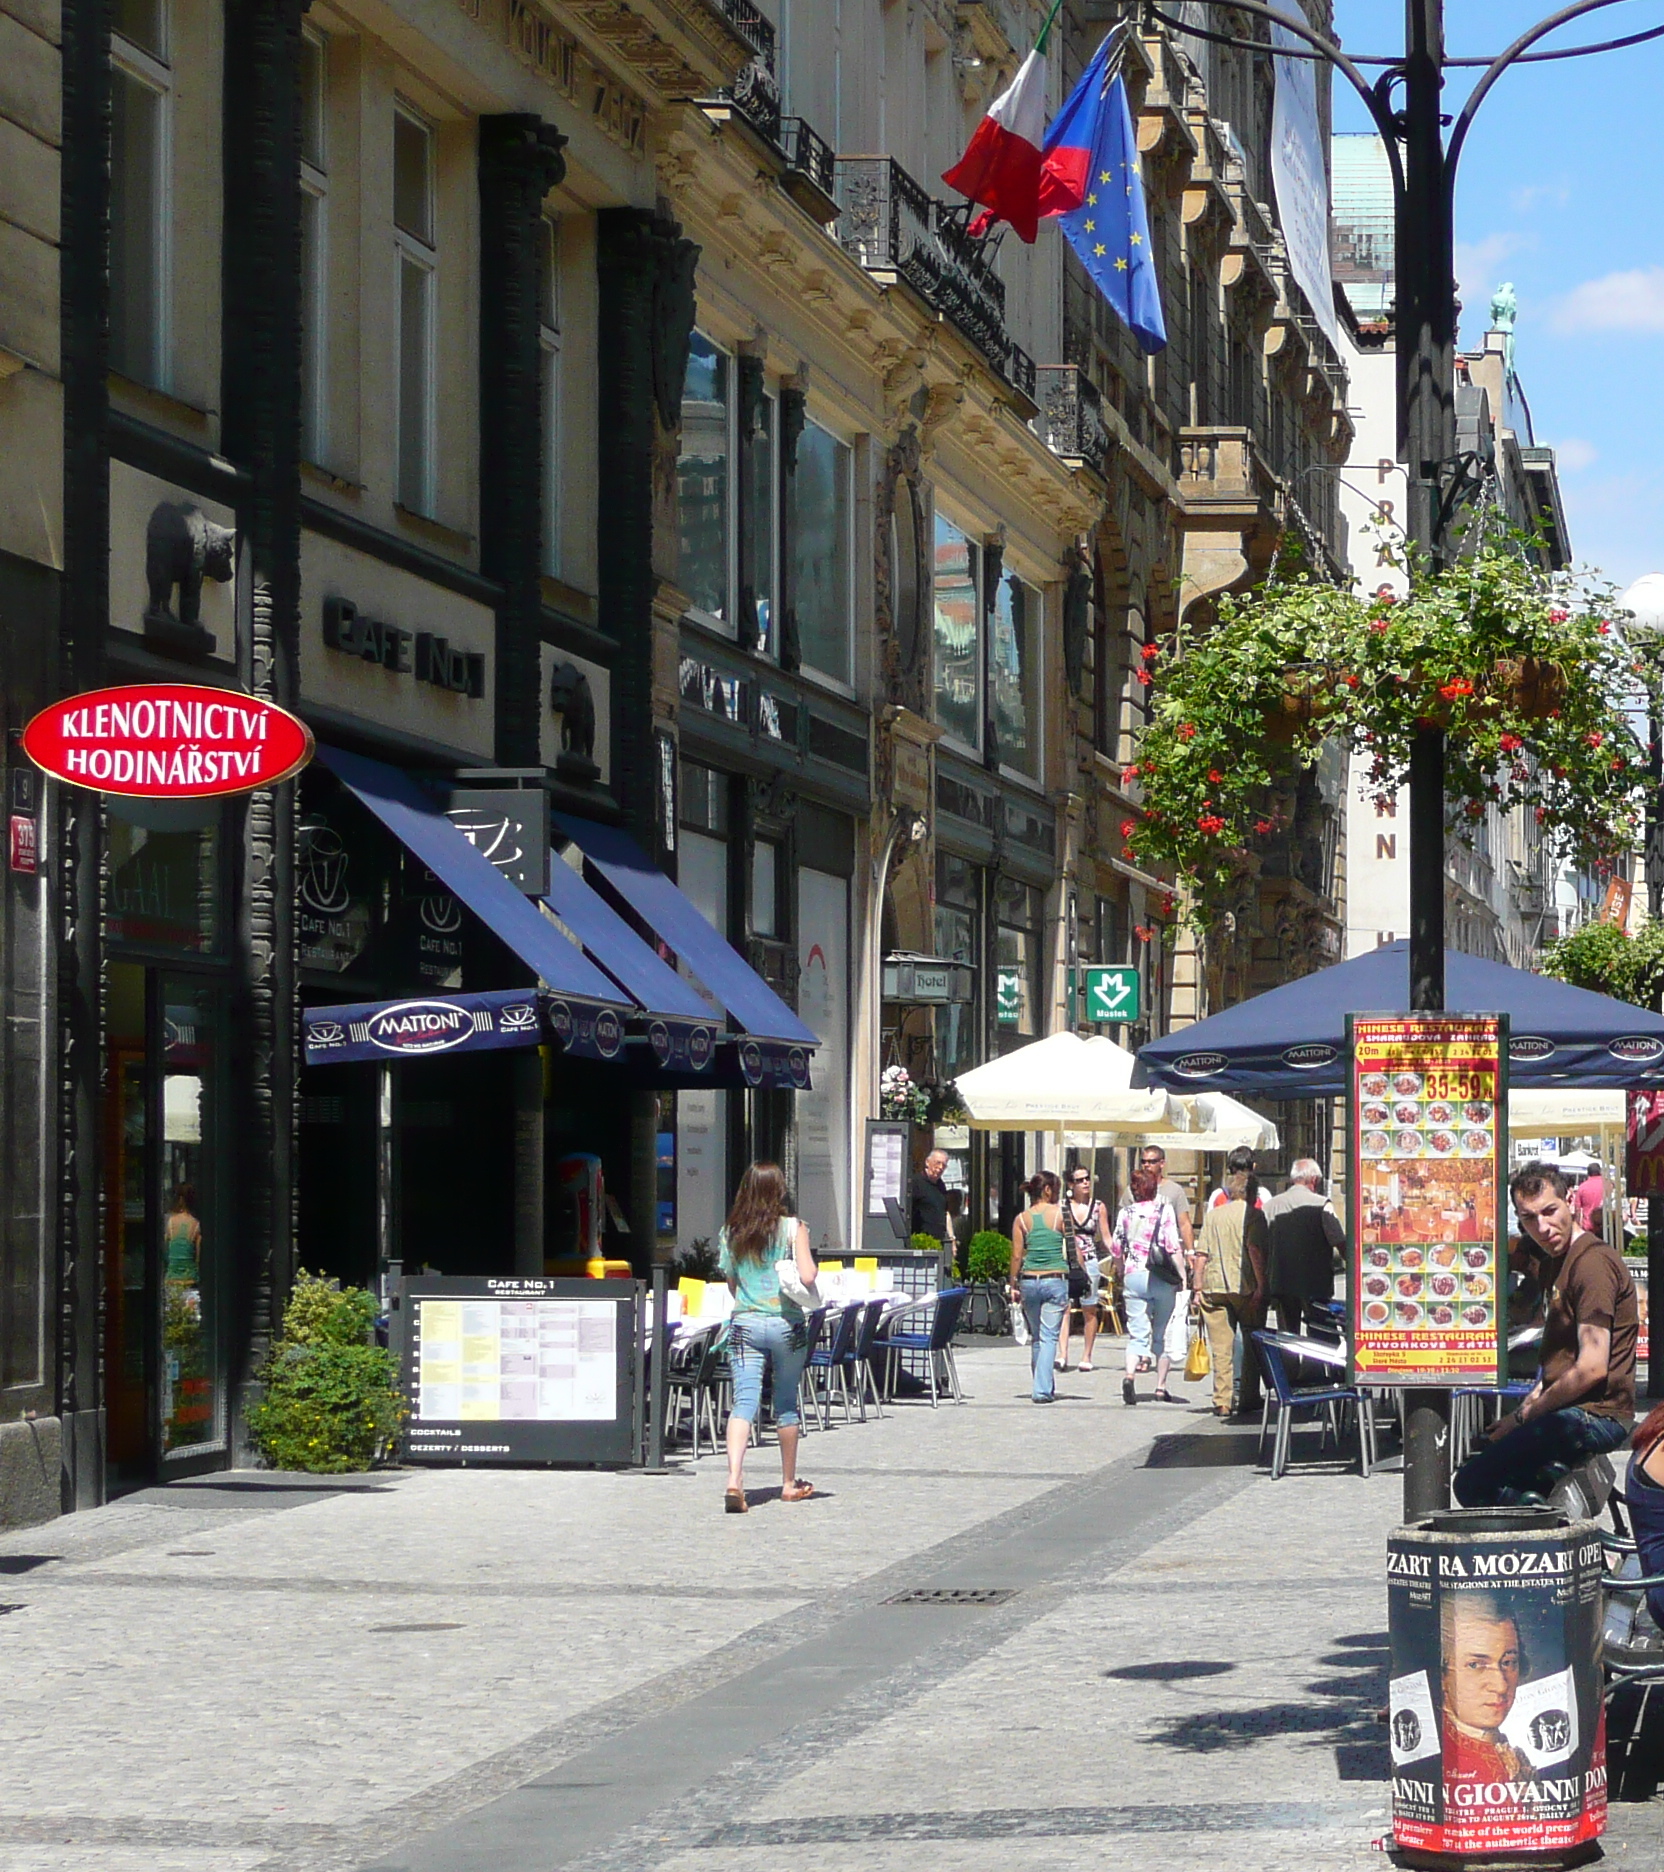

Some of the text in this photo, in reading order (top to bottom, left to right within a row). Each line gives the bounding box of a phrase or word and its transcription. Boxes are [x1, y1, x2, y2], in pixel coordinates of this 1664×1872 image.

[61, 699, 270, 741] KLENOTNICTVÍ
[66, 743, 263, 785] HODINÁŘSTVÍ
[17, 824, 35, 847] 375
[377, 1012, 461, 1036] MATTONI
[1358, 1046, 1379, 1056] 20m
[1615, 1039, 1656, 1053] MATTONI
[1178, 1055, 1222, 1070] MATTONI
[1287, 1048, 1332, 1062] MATTONI
[1426, 1073, 1481, 1100] 35-59
[487, 1279, 520, 1289] CAFE
[1411, 1332, 1498, 1341] RESTAURAN
[1473, 1549, 1574, 1576] MOZART
[1454, 1775, 1580, 1807] GIOVANNI
[1477, 1826, 1491, 1837] of
[1491, 1826, 1510, 1836] the
[1512, 1824, 1543, 1836] world
[1464, 1838, 1483, 1849] the
[1484, 1836, 1538, 1849] authentic
